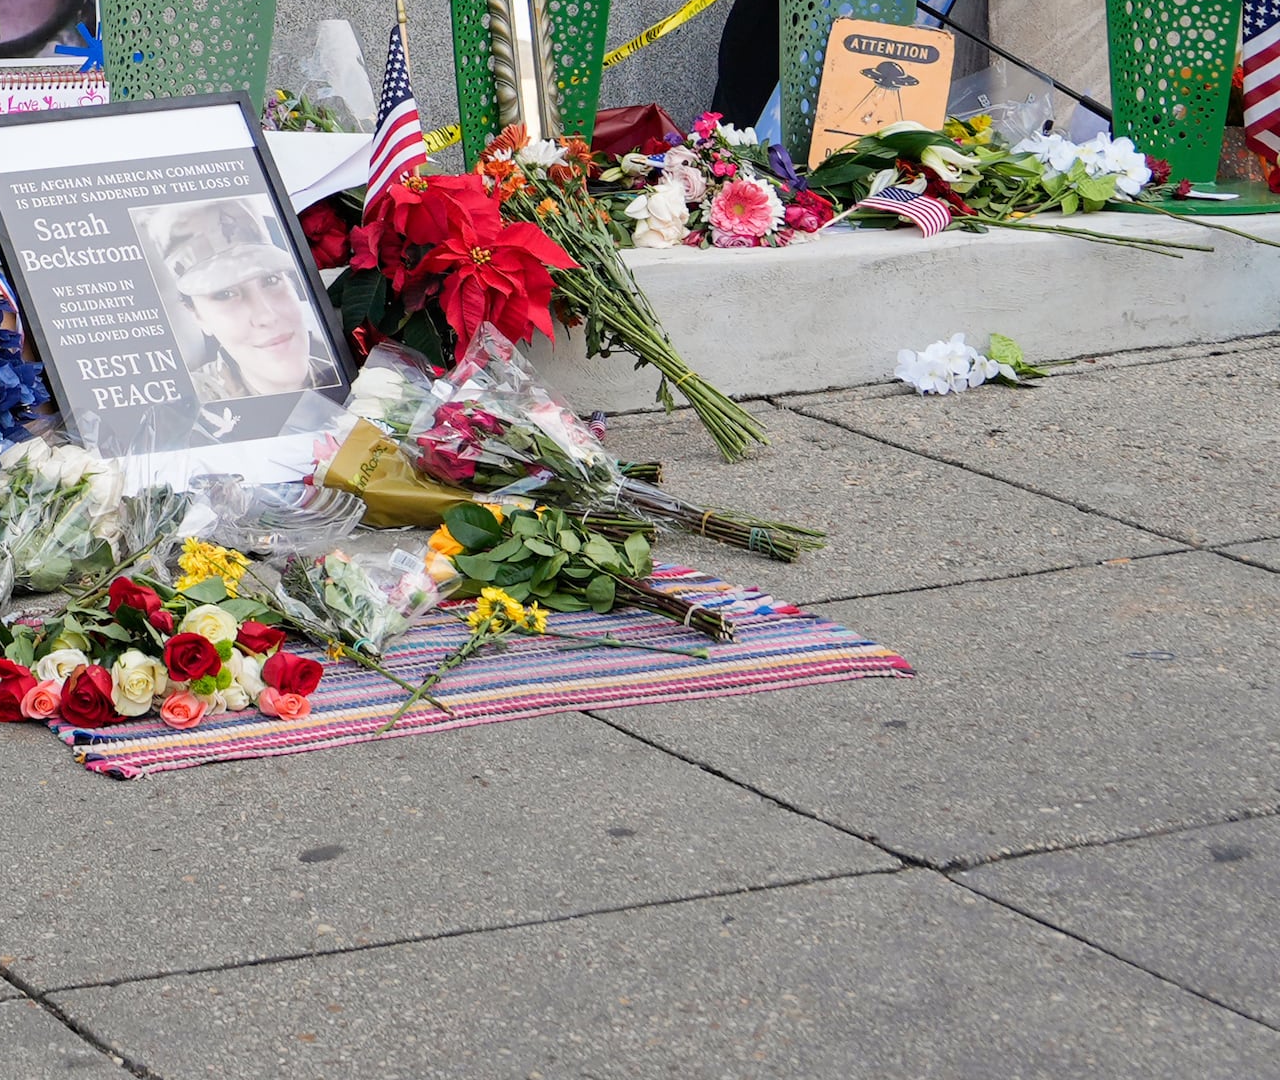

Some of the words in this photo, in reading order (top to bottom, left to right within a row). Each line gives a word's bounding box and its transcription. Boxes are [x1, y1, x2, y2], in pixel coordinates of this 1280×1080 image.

[850, 37, 929, 60] ATTENTION
[8, 95, 40, 111] Love
[10, 182, 38, 195] THE
[41, 176, 93, 192] AFGHAN
[97, 168, 163, 186] AMERICAN
[167, 160, 246, 179] COMMUNITY
[16, 198, 29, 210] IS
[32, 193, 78, 208] DEEPLY
[81, 186, 149, 203] SADDENED
[153, 184, 168, 196] BY
[170, 180, 197, 193] THE
[200, 176, 231, 190] LOSS
[234, 174, 250, 186] OF
[34, 213, 110, 241] Sarah
[20, 245, 143, 272] Beckstrom
[52, 286, 75, 297] WE
[76, 281, 117, 295] STAND
[119, 279, 135, 291] IN
[60, 295, 135, 313] SOLIDARITY
[52, 317, 88, 329] WITH
[90, 314, 116, 326] HER
[117, 308, 159, 323] FAMILY
[60, 333, 86, 346] AND
[88, 329, 129, 343] LOVED
[131, 324, 165, 338] ONES
[76, 353, 141, 380] REST
[145, 349, 178, 372] IN
[91, 379, 182, 410] PEACE
